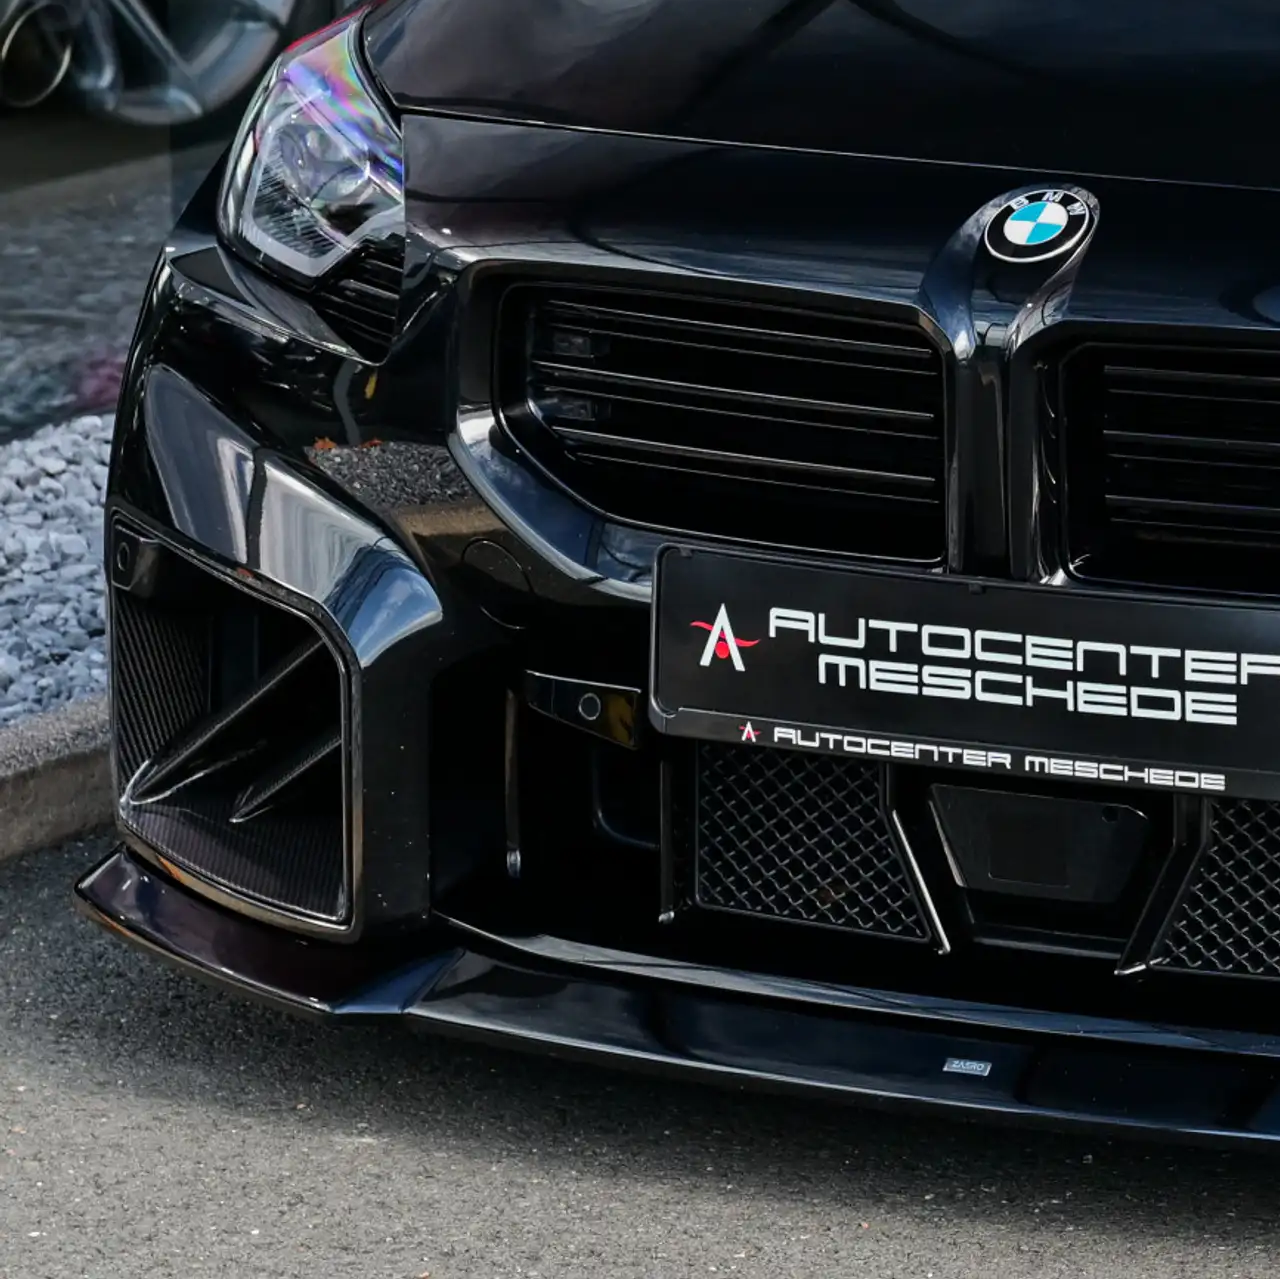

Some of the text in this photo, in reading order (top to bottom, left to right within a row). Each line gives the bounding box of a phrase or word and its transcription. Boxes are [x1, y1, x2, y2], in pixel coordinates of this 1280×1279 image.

[1010, 190, 1086, 216] BMW
[818, 654, 1238, 726] MESCHEDE
[773, 726, 1012, 770] AUTOCENTER
[1024, 755, 1226, 792] MESCHEDE
